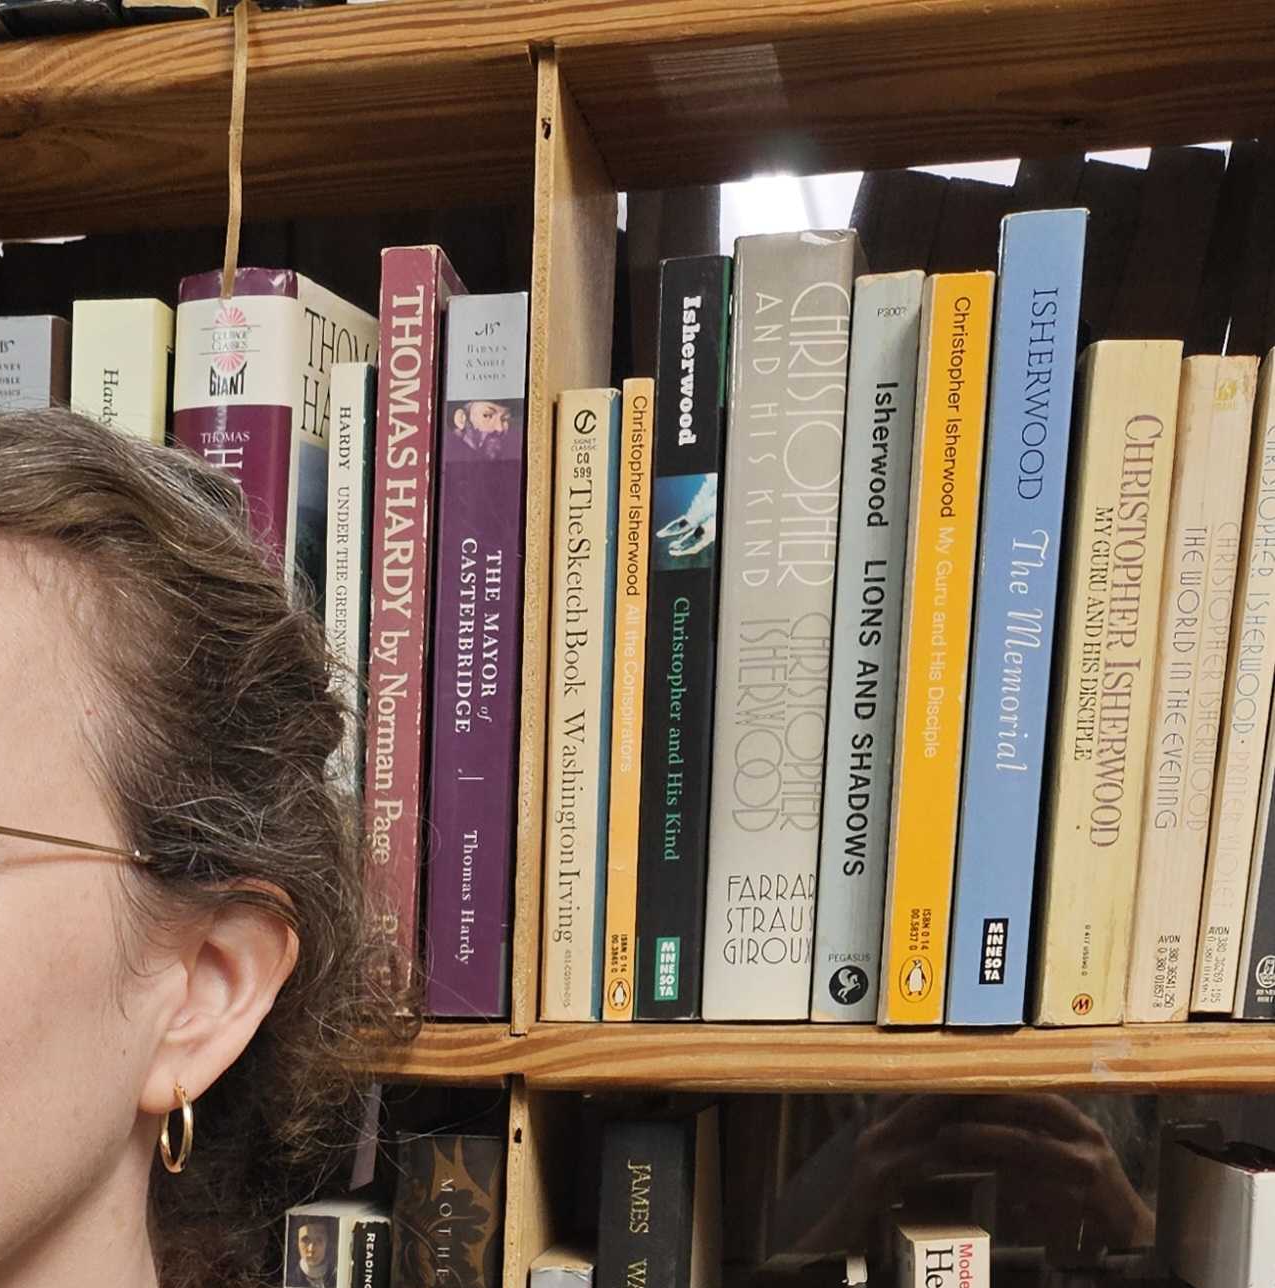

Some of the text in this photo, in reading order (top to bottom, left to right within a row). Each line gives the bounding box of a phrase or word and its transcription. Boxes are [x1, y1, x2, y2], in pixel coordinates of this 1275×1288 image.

[209, 361, 245, 396] GIANT
[678, 296, 701, 446] Isherwood
[200, 430, 250, 443] THOMAS
[338, 406, 351, 471] HARDY
[740, 291, 781, 586] AND HIS KIND
[775, 282, 851, 588] CHRISTOPHER
[335, 486, 350, 543] UNDER
[335, 548, 348, 581] THE
[565, 480, 592, 536] The
[995, 288, 1059, 771] ISHERWOOD The Memorial
[369, 286, 424, 864] THOMAS HARDY by Norman Page
[563, 536, 591, 625] Sketch
[842, 383, 898, 877] Isherwood LIONS AND SHADOWS
[1089, 414, 1164, 847] CHRISTOPHER ISHERWOOD
[455, 538, 478, 734] CASTERBRIDGE
[562, 630, 588, 697] Book
[779, 612, 830, 831] CHRISTOPHER
[553, 709, 585, 865] Washington
[552, 871, 581, 944] Irving
[628, 1160, 651, 1233] JAMES
